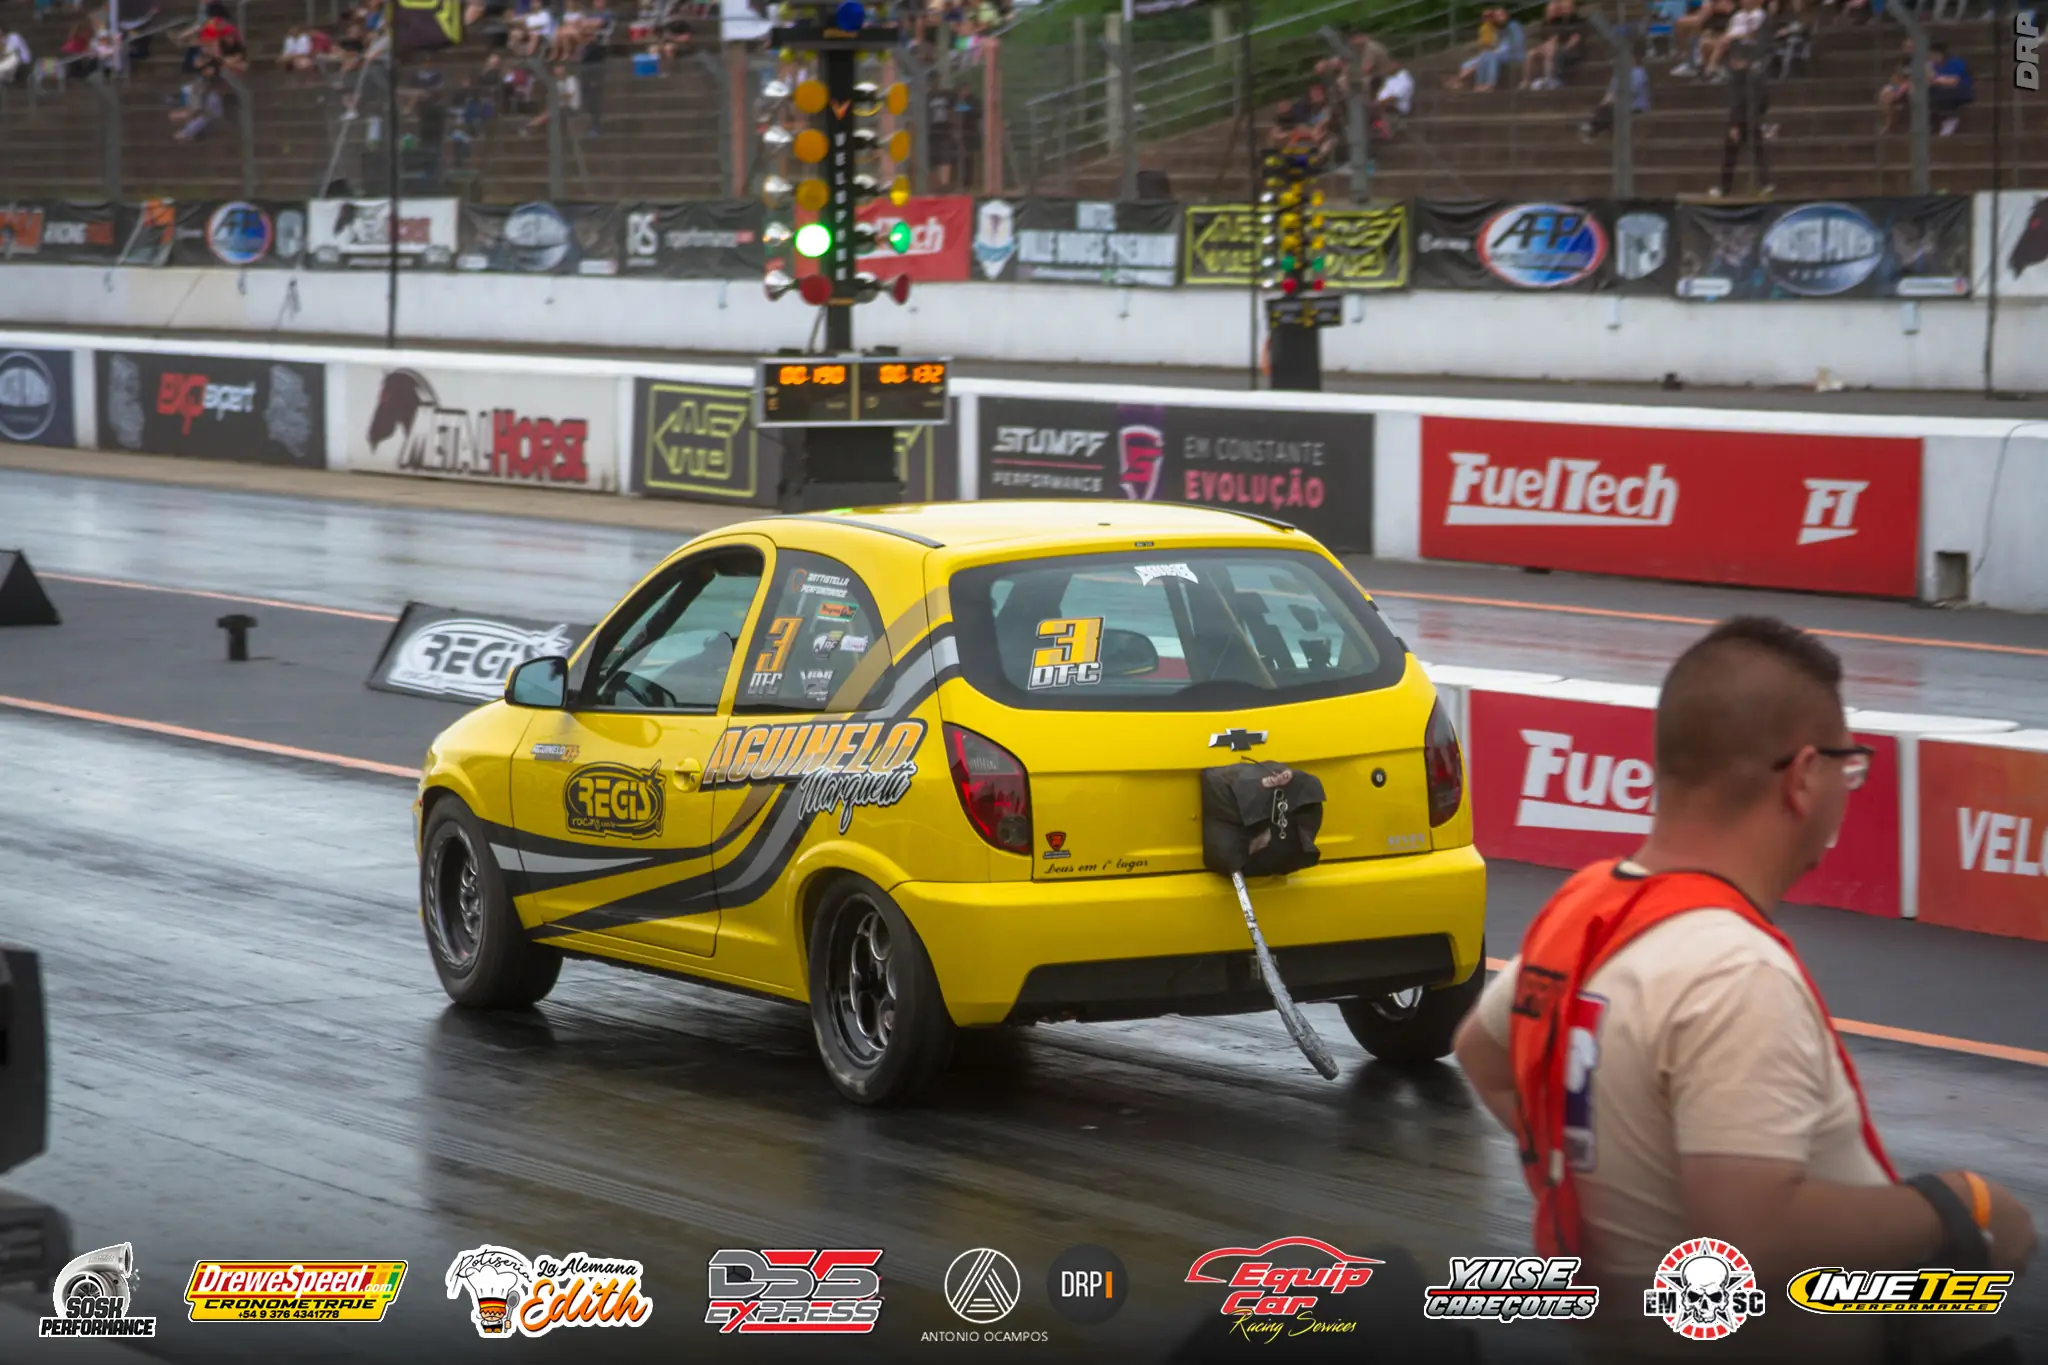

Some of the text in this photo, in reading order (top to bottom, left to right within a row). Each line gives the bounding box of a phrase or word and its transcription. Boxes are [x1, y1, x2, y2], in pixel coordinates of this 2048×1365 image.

[992, 426, 1110, 457] STUMPF
[1184, 435, 1325, 466] EM CONSTANTE
[992, 471, 1104, 492] PERFORMANCE
[1184, 468, 1326, 511] EVOLUÇÃO
[1447, 451, 1679, 522] FuelTech
[754, 616, 805, 673] 3
[1035, 617, 1104, 668] 3
[703, 721, 924, 785] AGUINELO
[578, 776, 651, 821] REGIS
[1078, 863, 1098, 873] em
[1116, 858, 1149, 873] lugar
